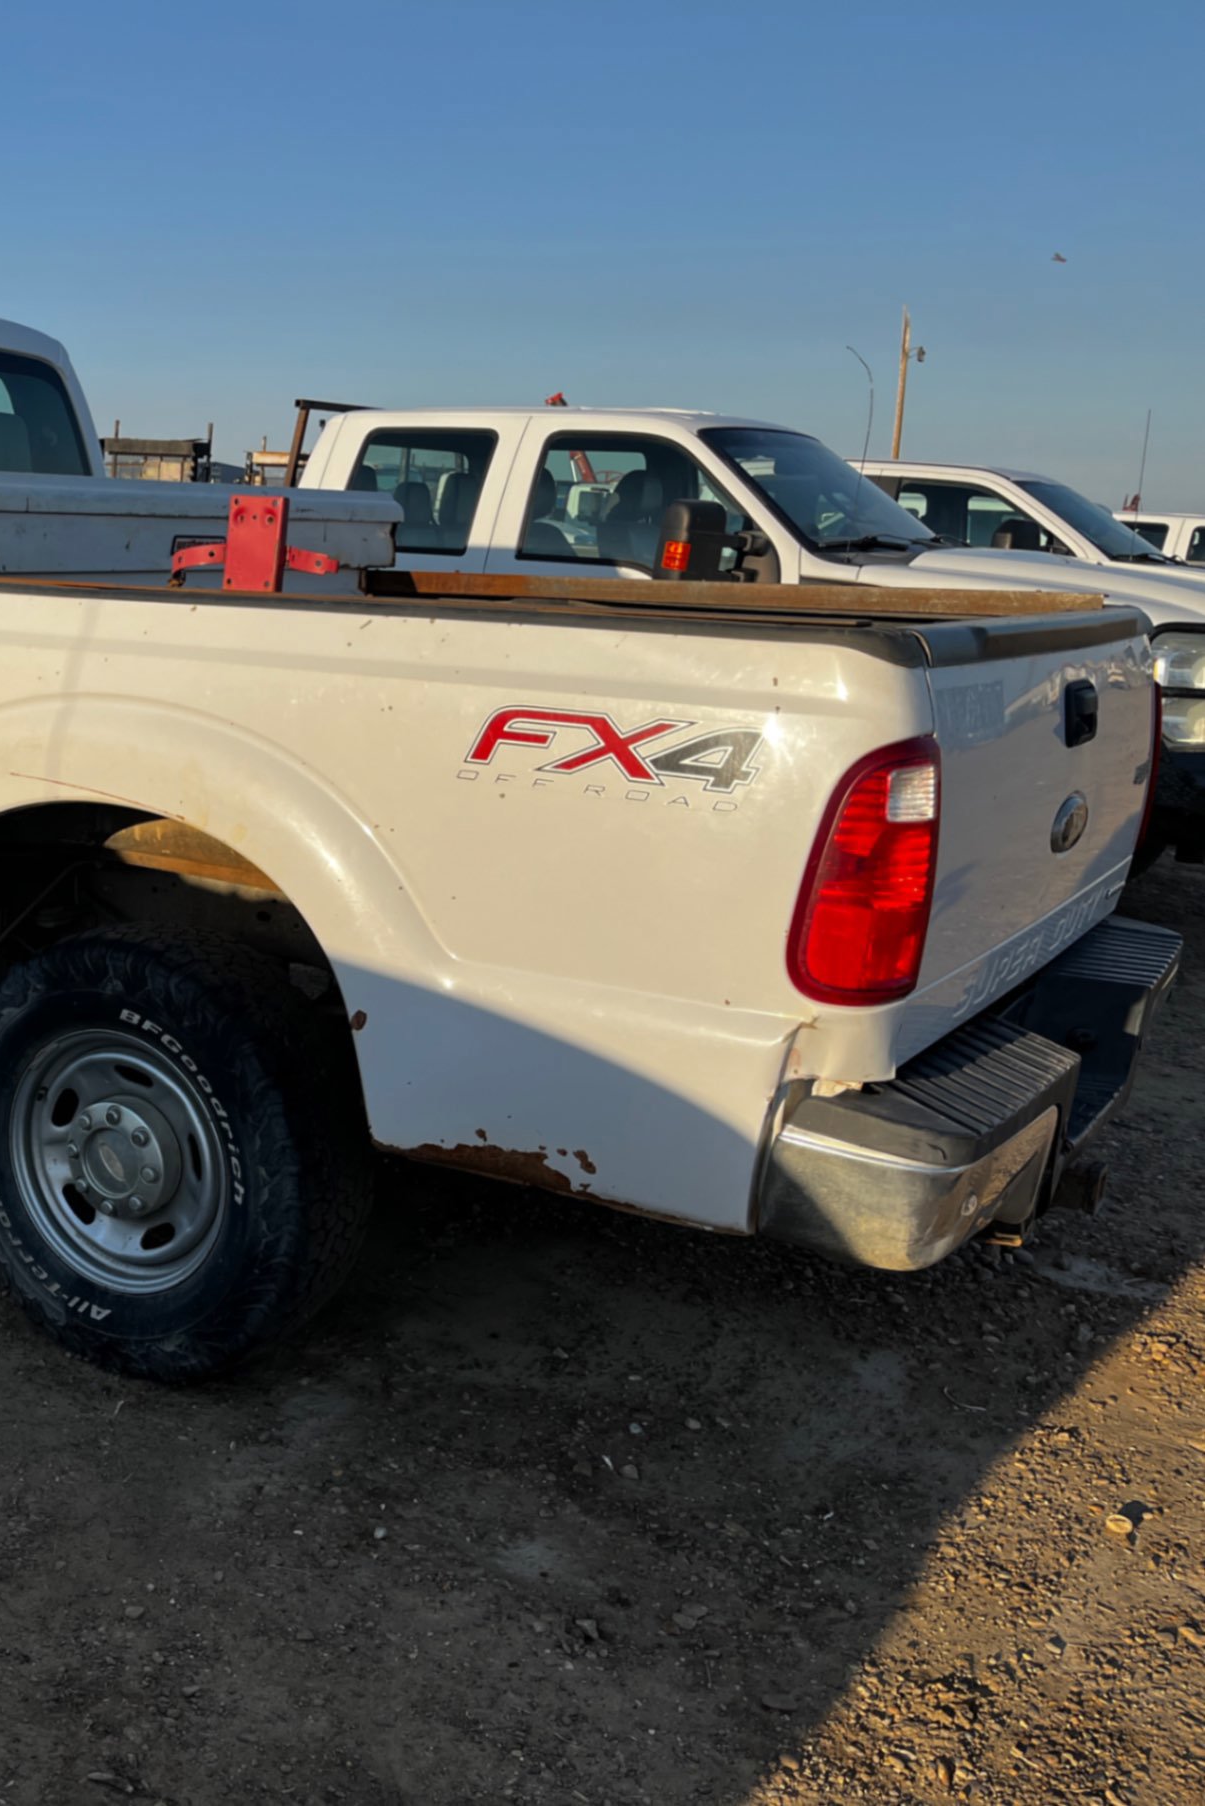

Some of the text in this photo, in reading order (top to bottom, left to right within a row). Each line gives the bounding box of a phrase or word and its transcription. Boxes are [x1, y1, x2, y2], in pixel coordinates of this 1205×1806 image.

[456, 769, 739, 813] OFF ROAD
[464, 704, 764, 793] FX4
[953, 887, 1105, 1018] SUPER DUTY
[119, 1008, 244, 1206] BFGoodrich
